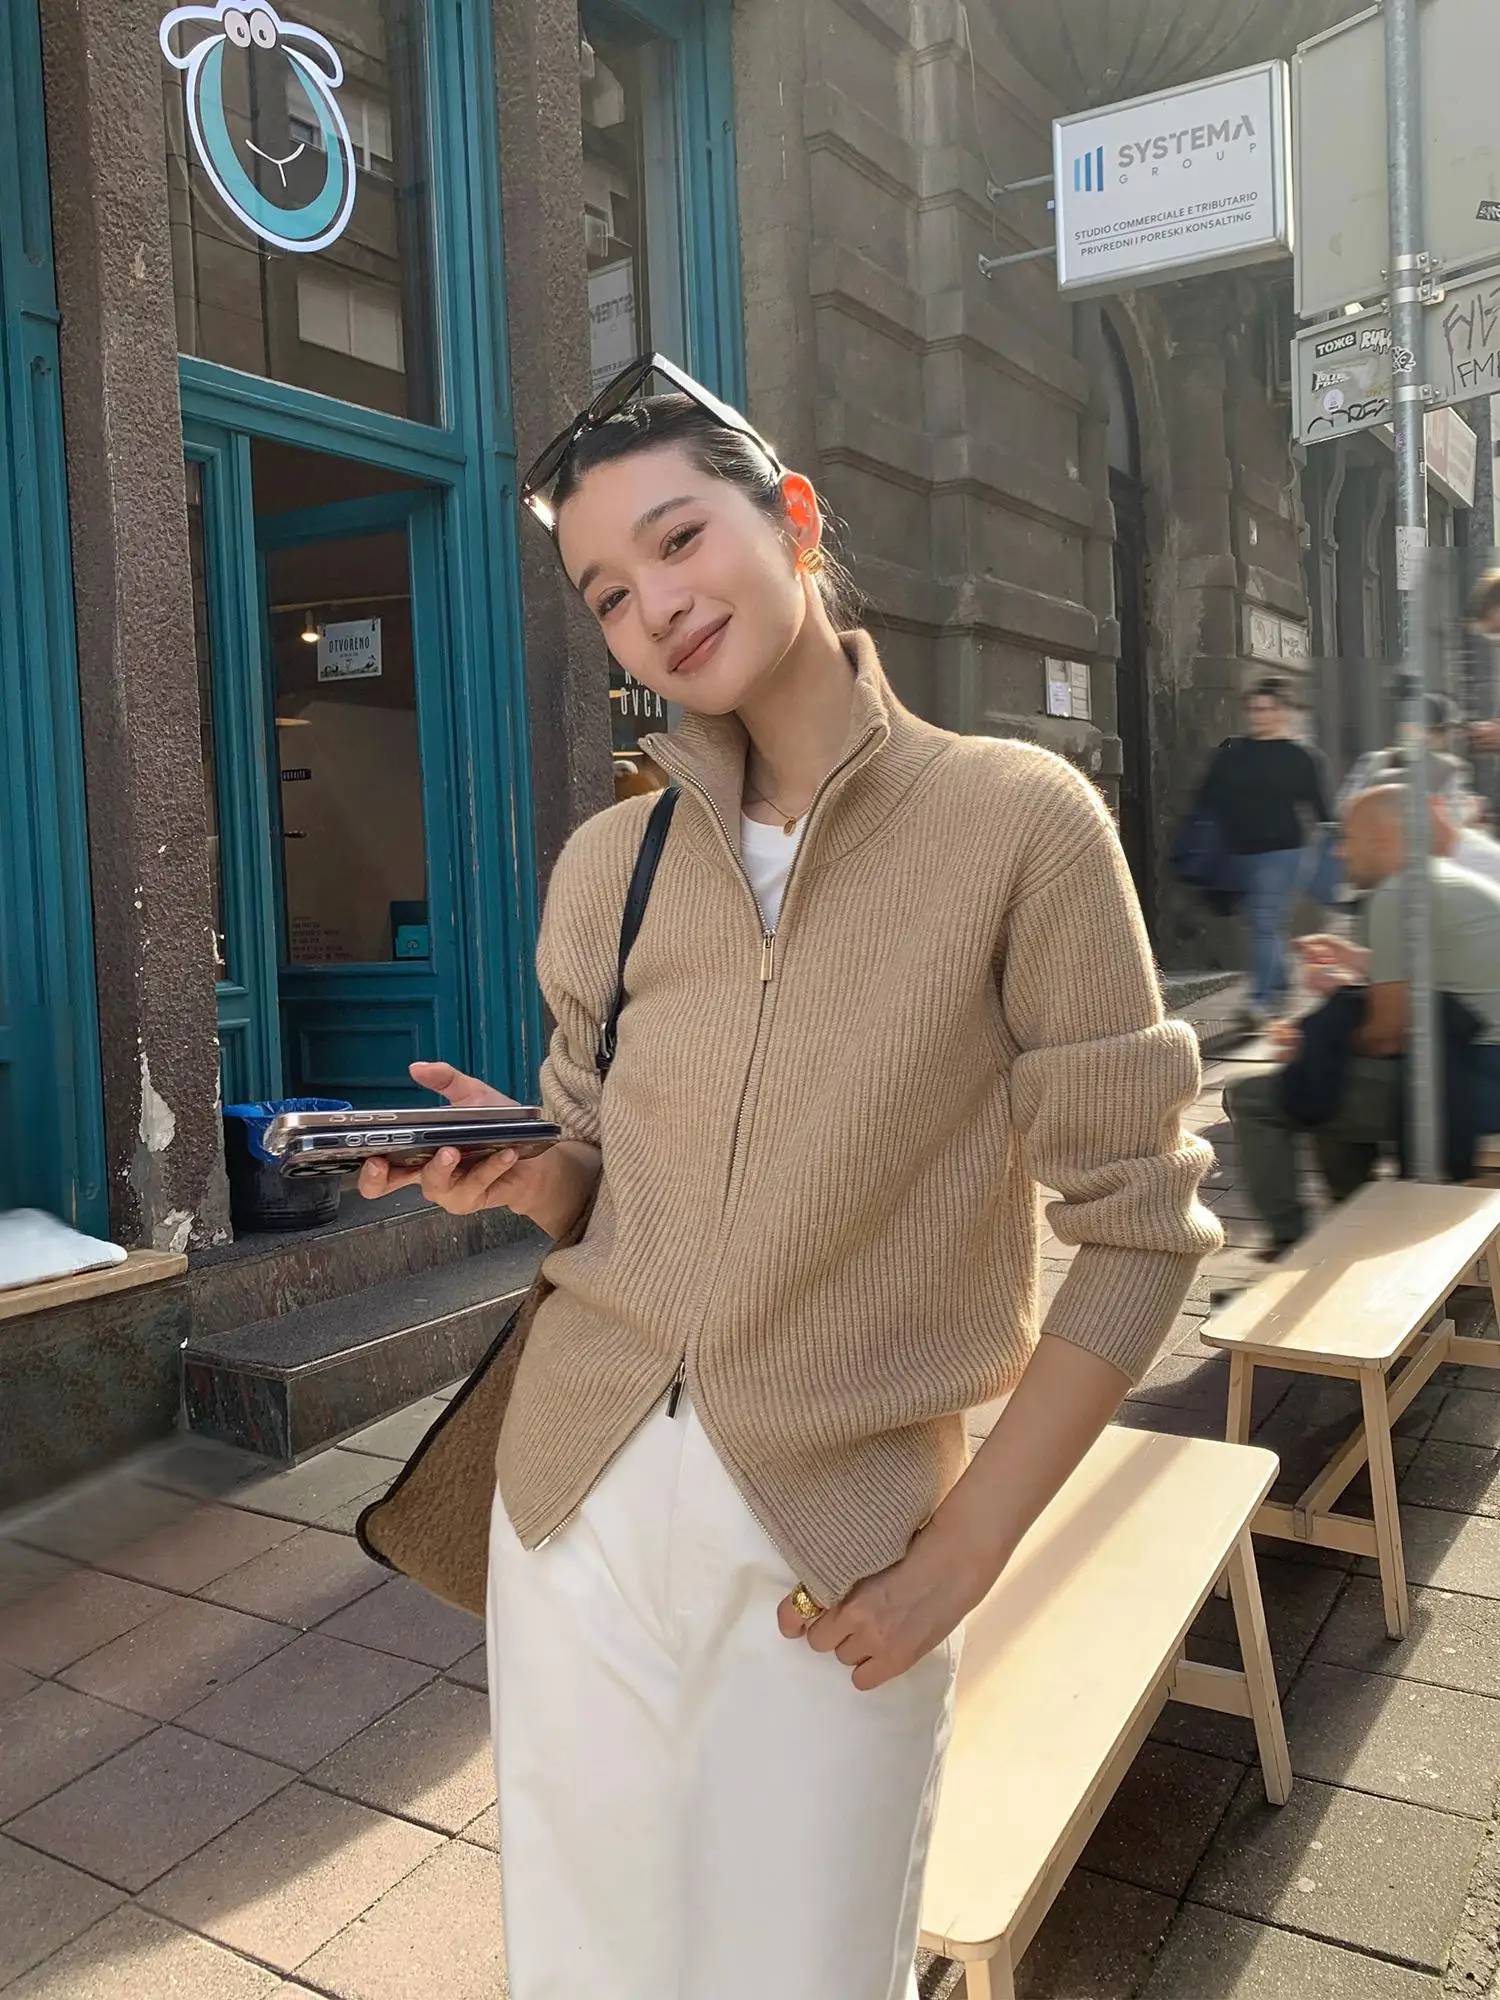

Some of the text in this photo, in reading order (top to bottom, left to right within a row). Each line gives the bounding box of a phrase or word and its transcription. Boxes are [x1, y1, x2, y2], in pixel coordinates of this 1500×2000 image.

[1118, 115, 1256, 168] SYSTEMA
[1118, 142, 1257, 185] GROUP
[1074, 191, 1258, 241] STUDIO COMMERCIALE E TRIBUTARIO
[1080, 238, 1134, 257] PRIVREDNI
[1140, 228, 1184, 244] PORESKI
[1185, 211, 1252, 235] KONSALTING
[328, 635, 370, 653] OTVORENO
[620, 687, 663, 718] OVCA
